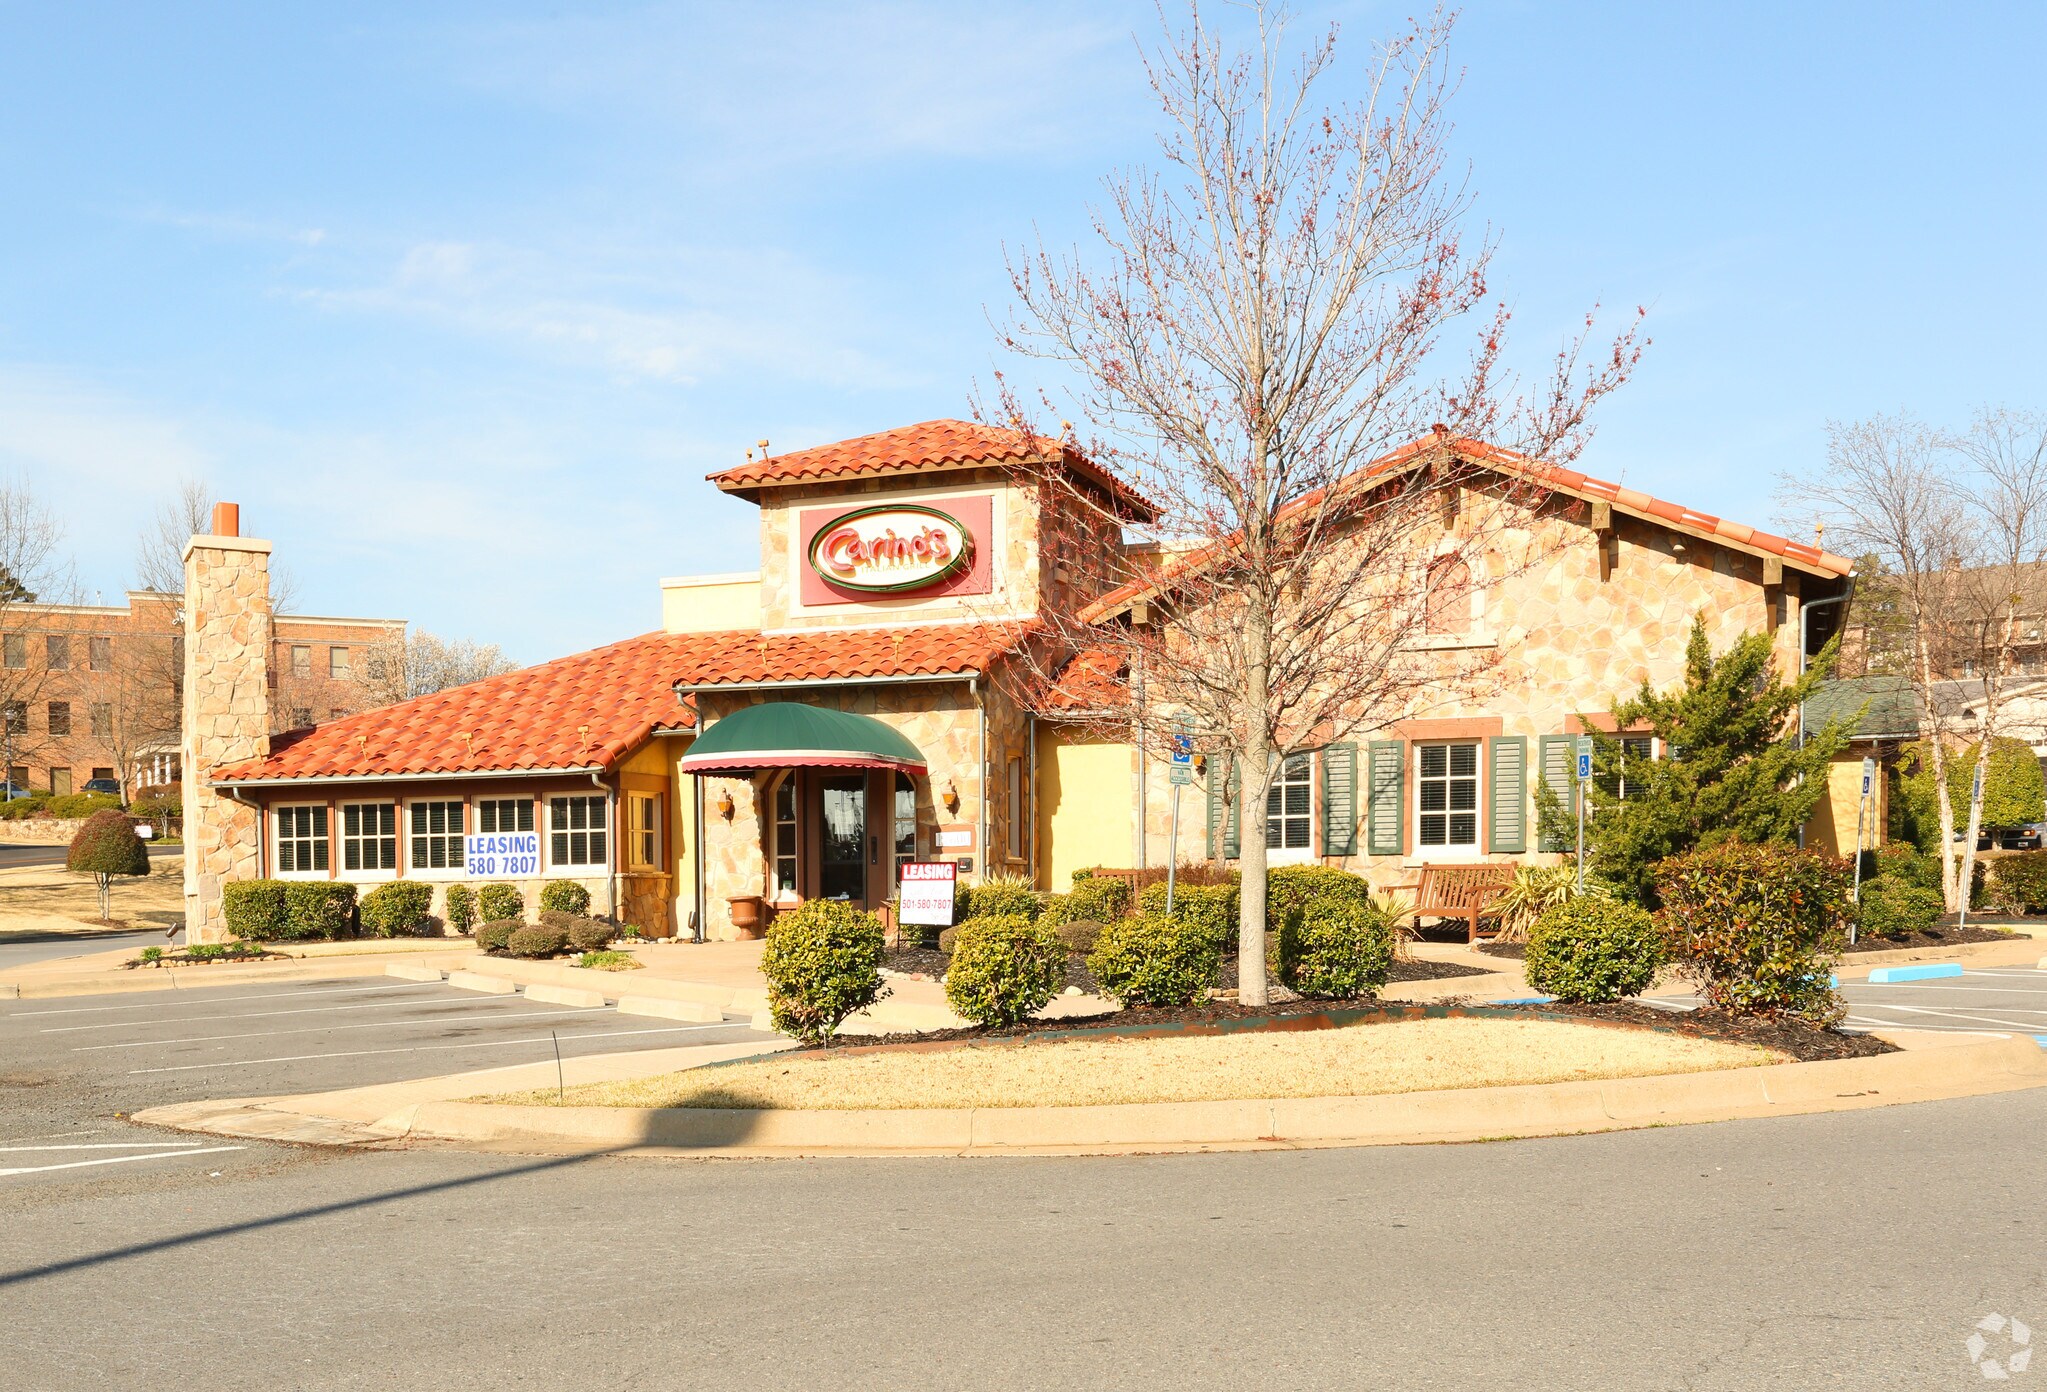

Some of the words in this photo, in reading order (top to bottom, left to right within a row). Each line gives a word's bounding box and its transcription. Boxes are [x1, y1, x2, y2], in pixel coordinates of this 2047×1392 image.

[822, 525, 947, 571] Carino's
[468, 835, 536, 854] LEASING
[468, 856, 496, 875] 580
[502, 856, 536, 874] 7807
[903, 864, 953, 880] LEASING
